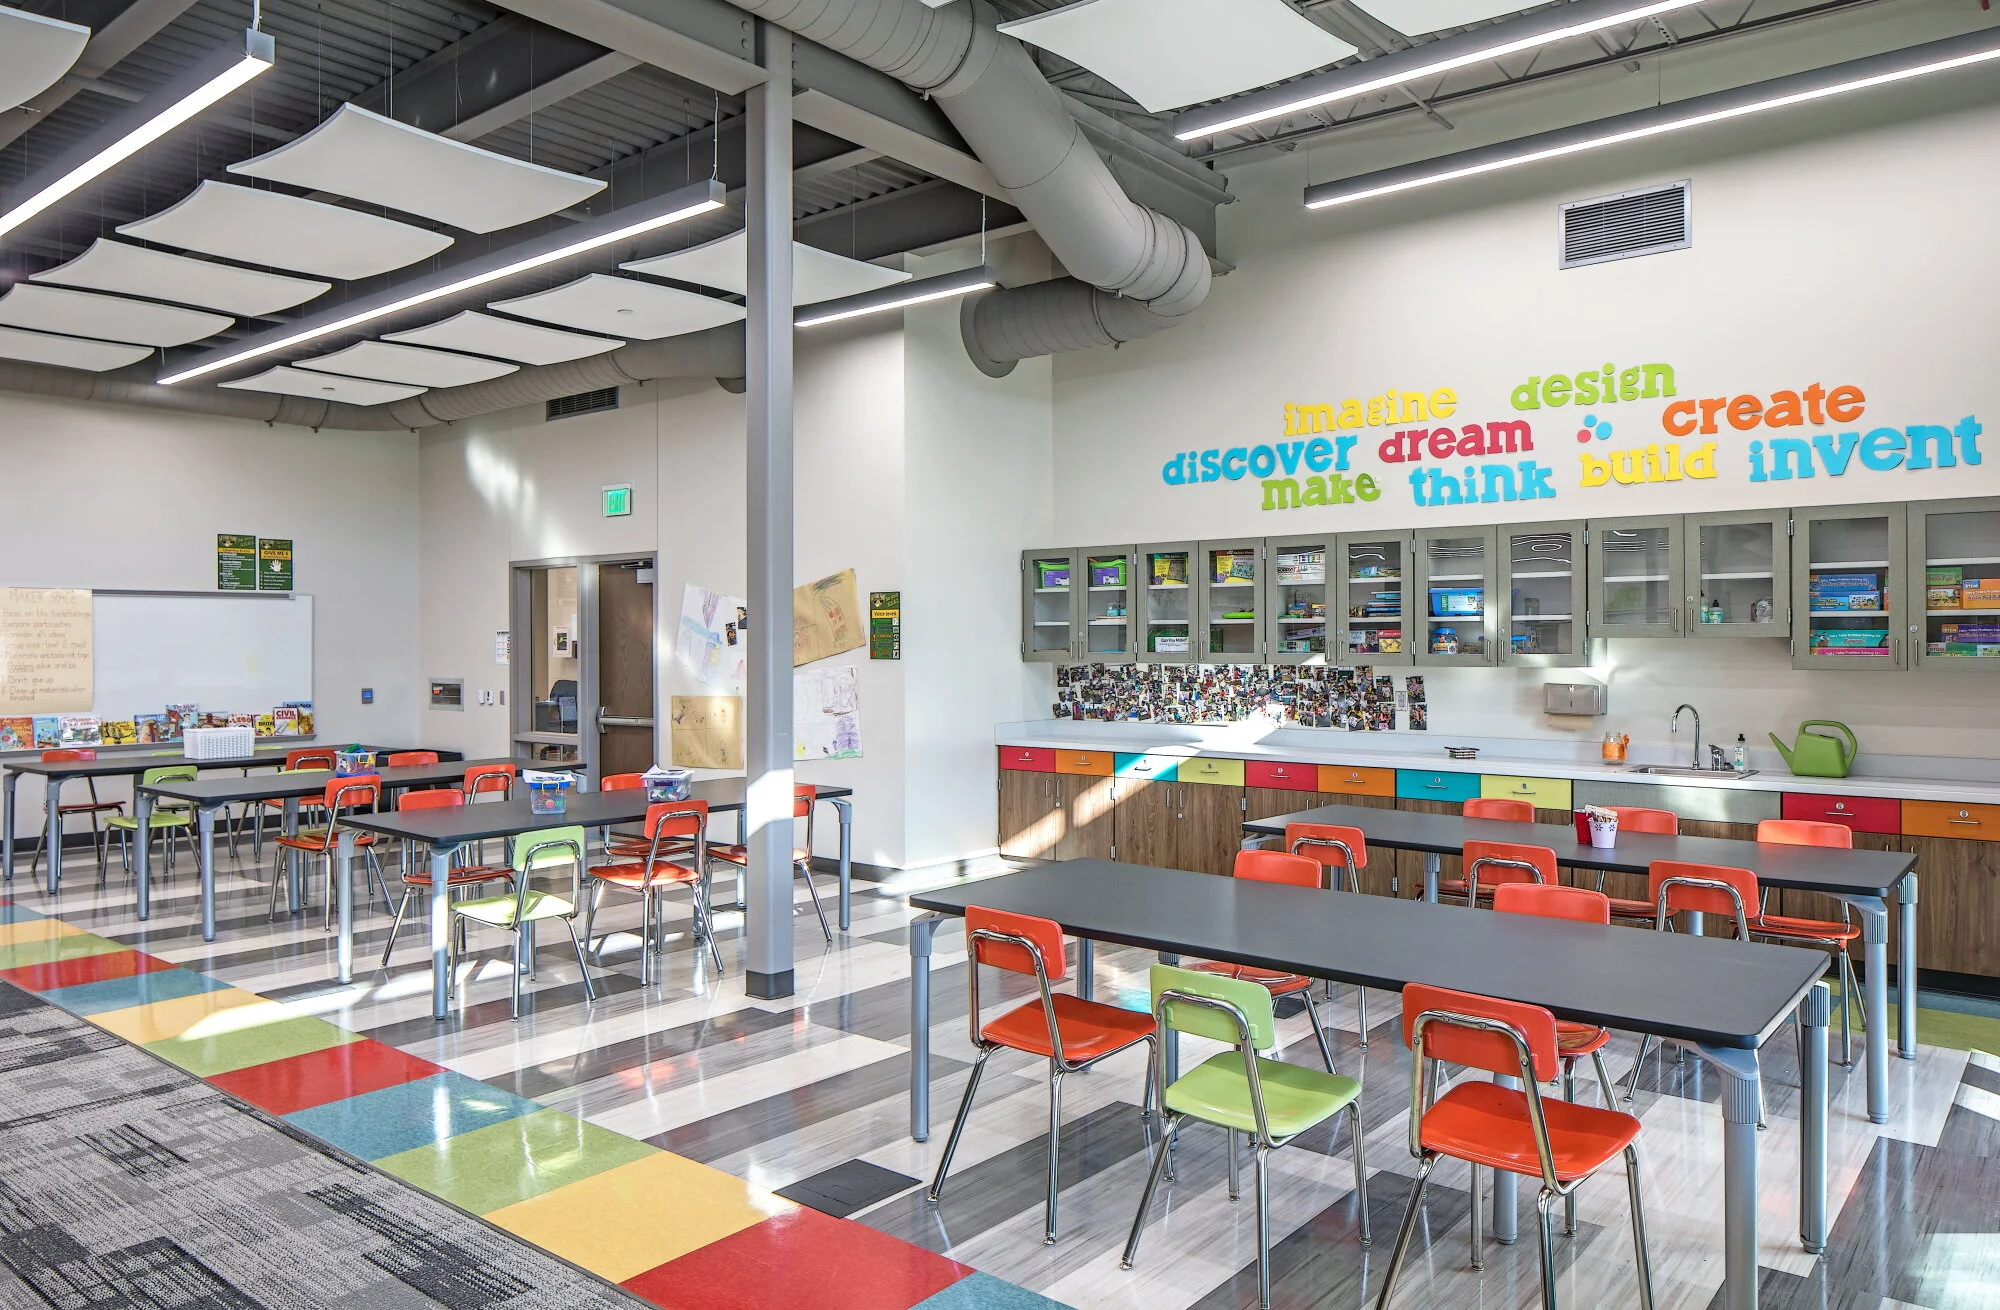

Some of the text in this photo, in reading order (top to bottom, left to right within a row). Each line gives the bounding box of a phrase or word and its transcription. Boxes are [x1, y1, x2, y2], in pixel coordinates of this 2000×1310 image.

[1511, 363, 1676, 410] design
[1662, 383, 1865, 436] create
[1284, 387, 1456, 437] imagine
[1162, 434, 1357, 486] discover
[1379, 420, 1533, 463] dream
[1580, 442, 1717, 487] build
[1749, 416, 1982, 482] invent
[1262, 474, 1381, 510] make
[1409, 461, 1556, 506] think
